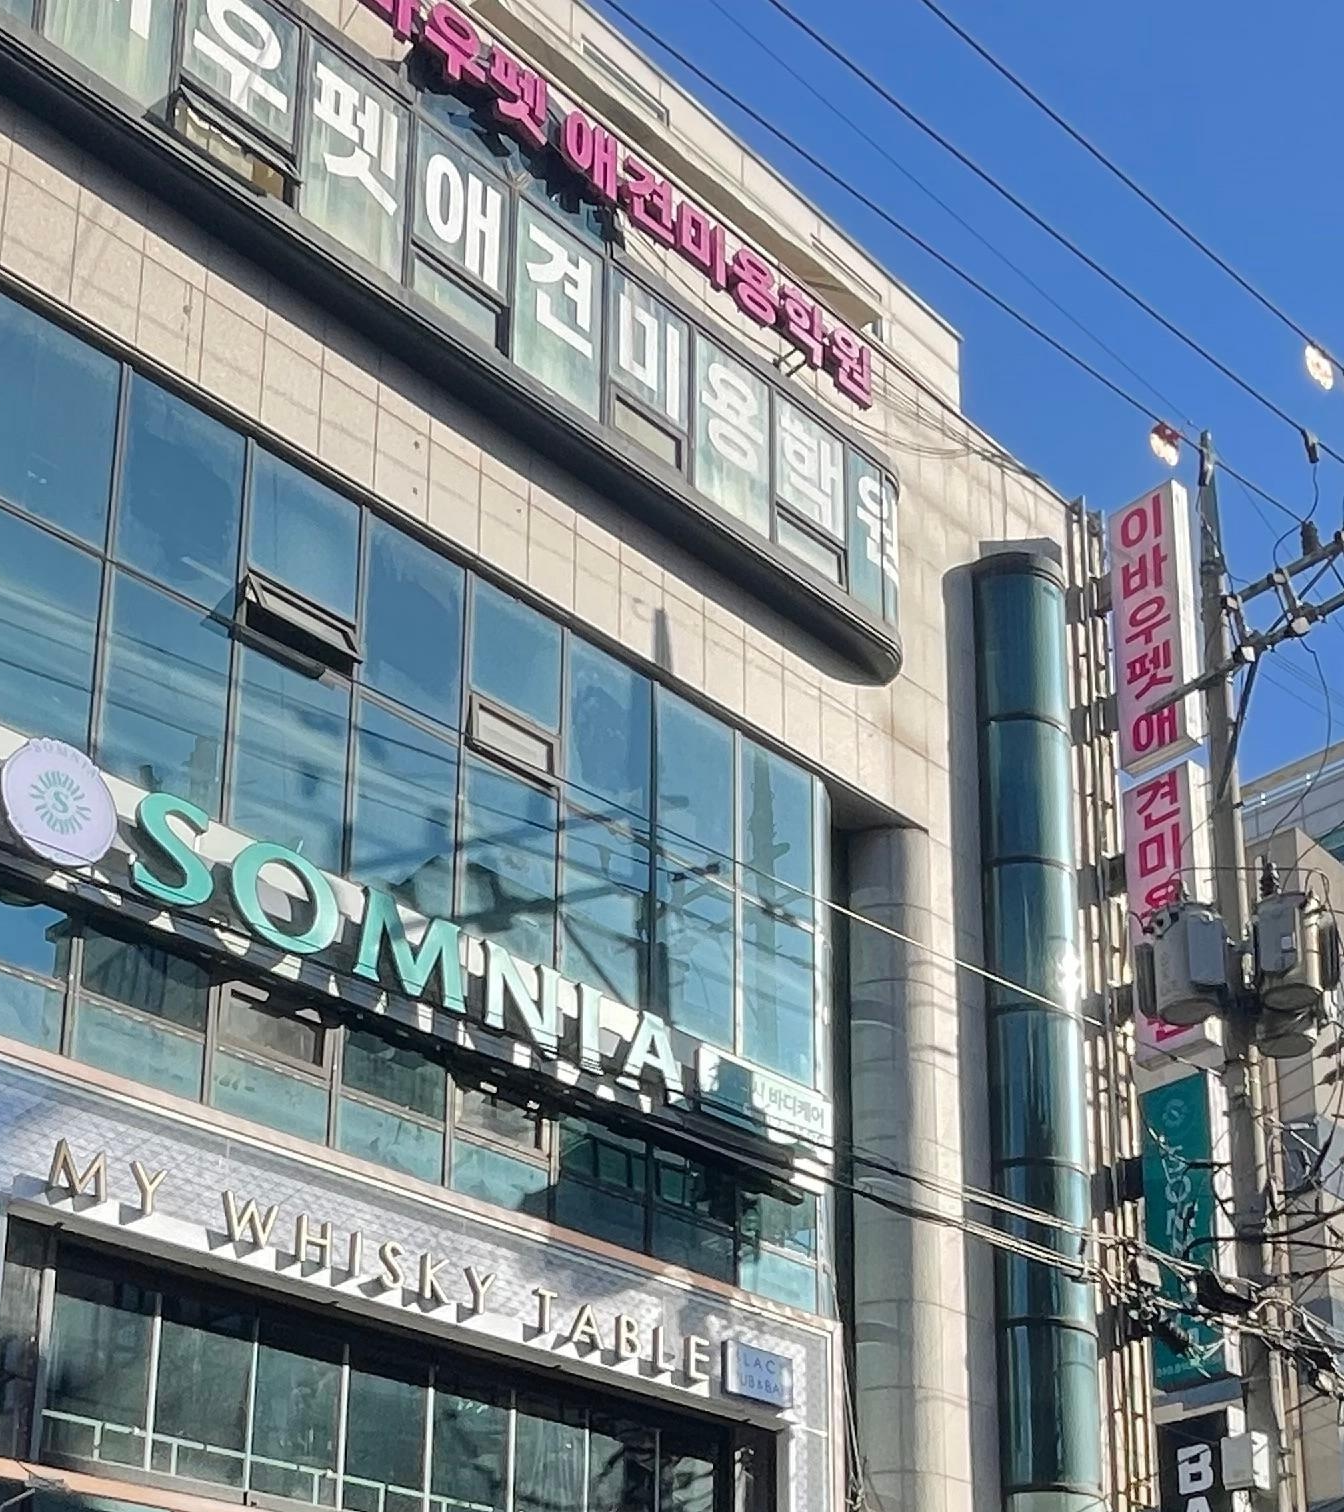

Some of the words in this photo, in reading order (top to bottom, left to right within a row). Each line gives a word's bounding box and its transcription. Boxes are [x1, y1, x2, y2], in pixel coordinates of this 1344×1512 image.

[564, 108, 873, 410] 애견미용학원
[130, 791, 685, 1092] SOMNIA
[47, 1138, 169, 1215] MY
[222, 1189, 498, 1314] WHISKY
[532, 1286, 712, 1386] TABLE
